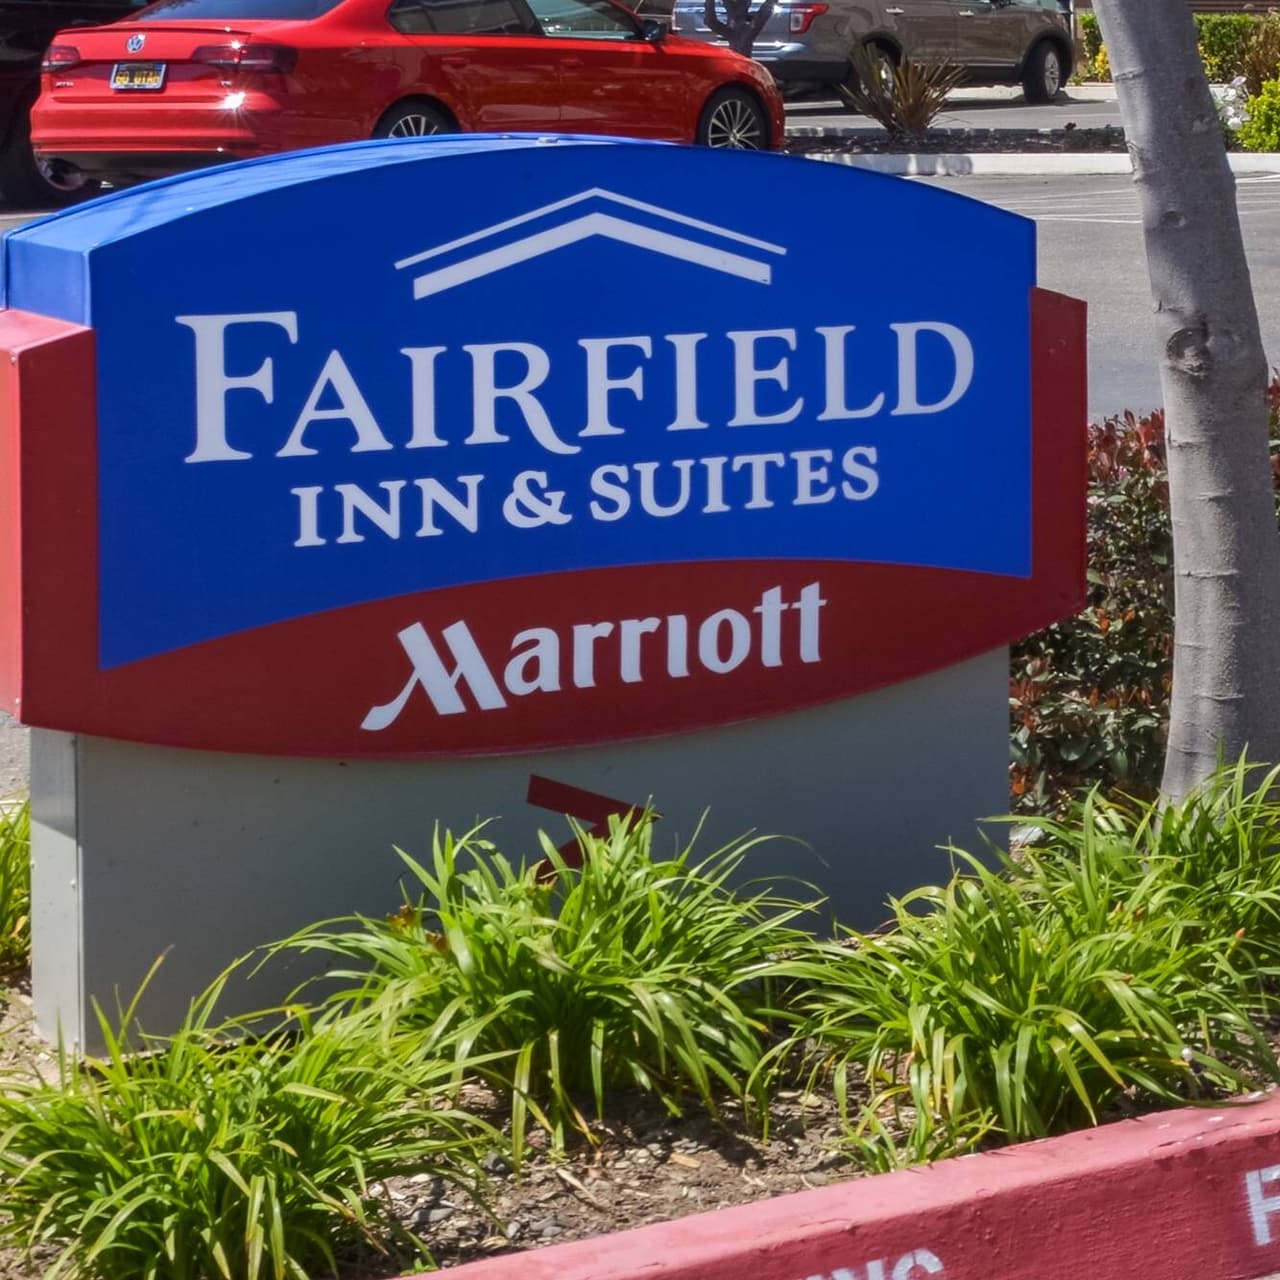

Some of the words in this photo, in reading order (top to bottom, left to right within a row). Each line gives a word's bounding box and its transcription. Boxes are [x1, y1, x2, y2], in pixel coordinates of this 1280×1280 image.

[177, 311, 975, 463] FAIRFIELD
[291, 474, 484, 548] INN
[503, 470, 573, 529] &
[590, 446, 880, 522] SUITES
[360, 581, 827, 731] Marriott
